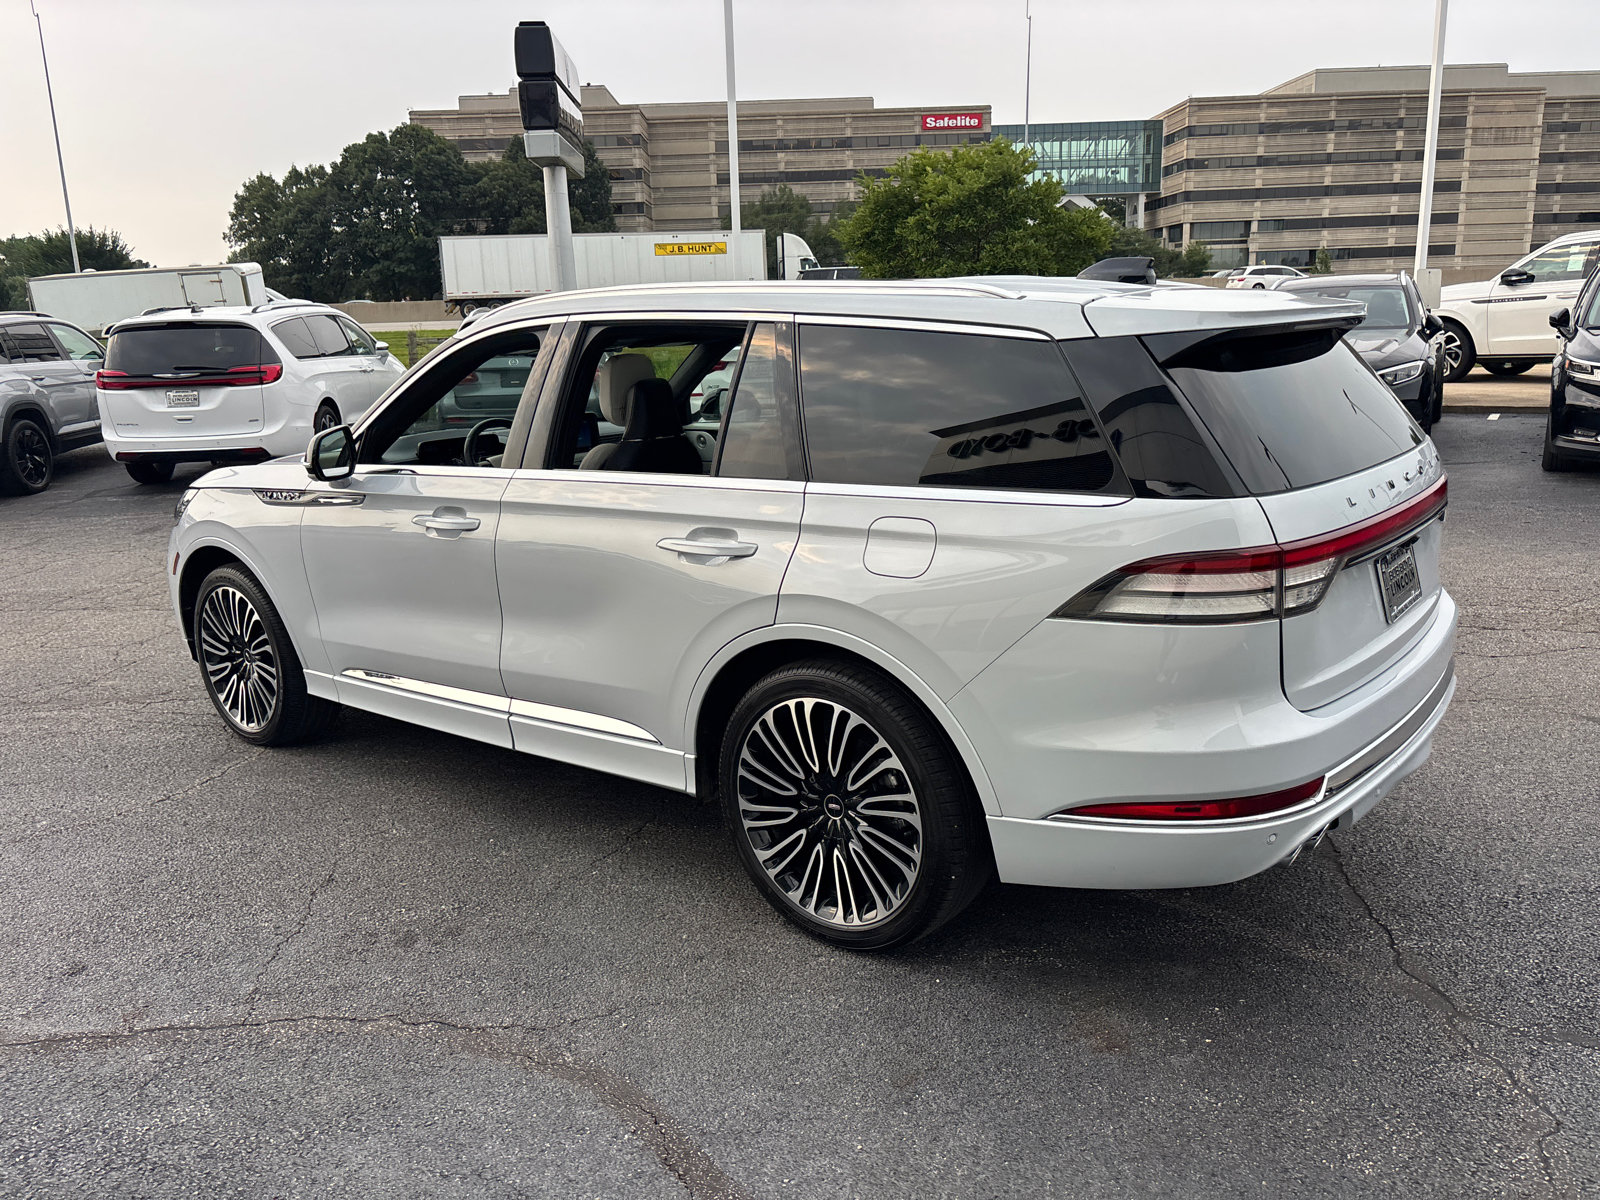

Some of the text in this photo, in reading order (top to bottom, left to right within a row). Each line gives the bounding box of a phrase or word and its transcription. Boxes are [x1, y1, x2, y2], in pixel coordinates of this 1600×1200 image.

[926, 116, 979, 128] Safelite
[669, 245, 713, 253] J.B. HUNT
[1390, 567, 1416, 597] LINCOLN
